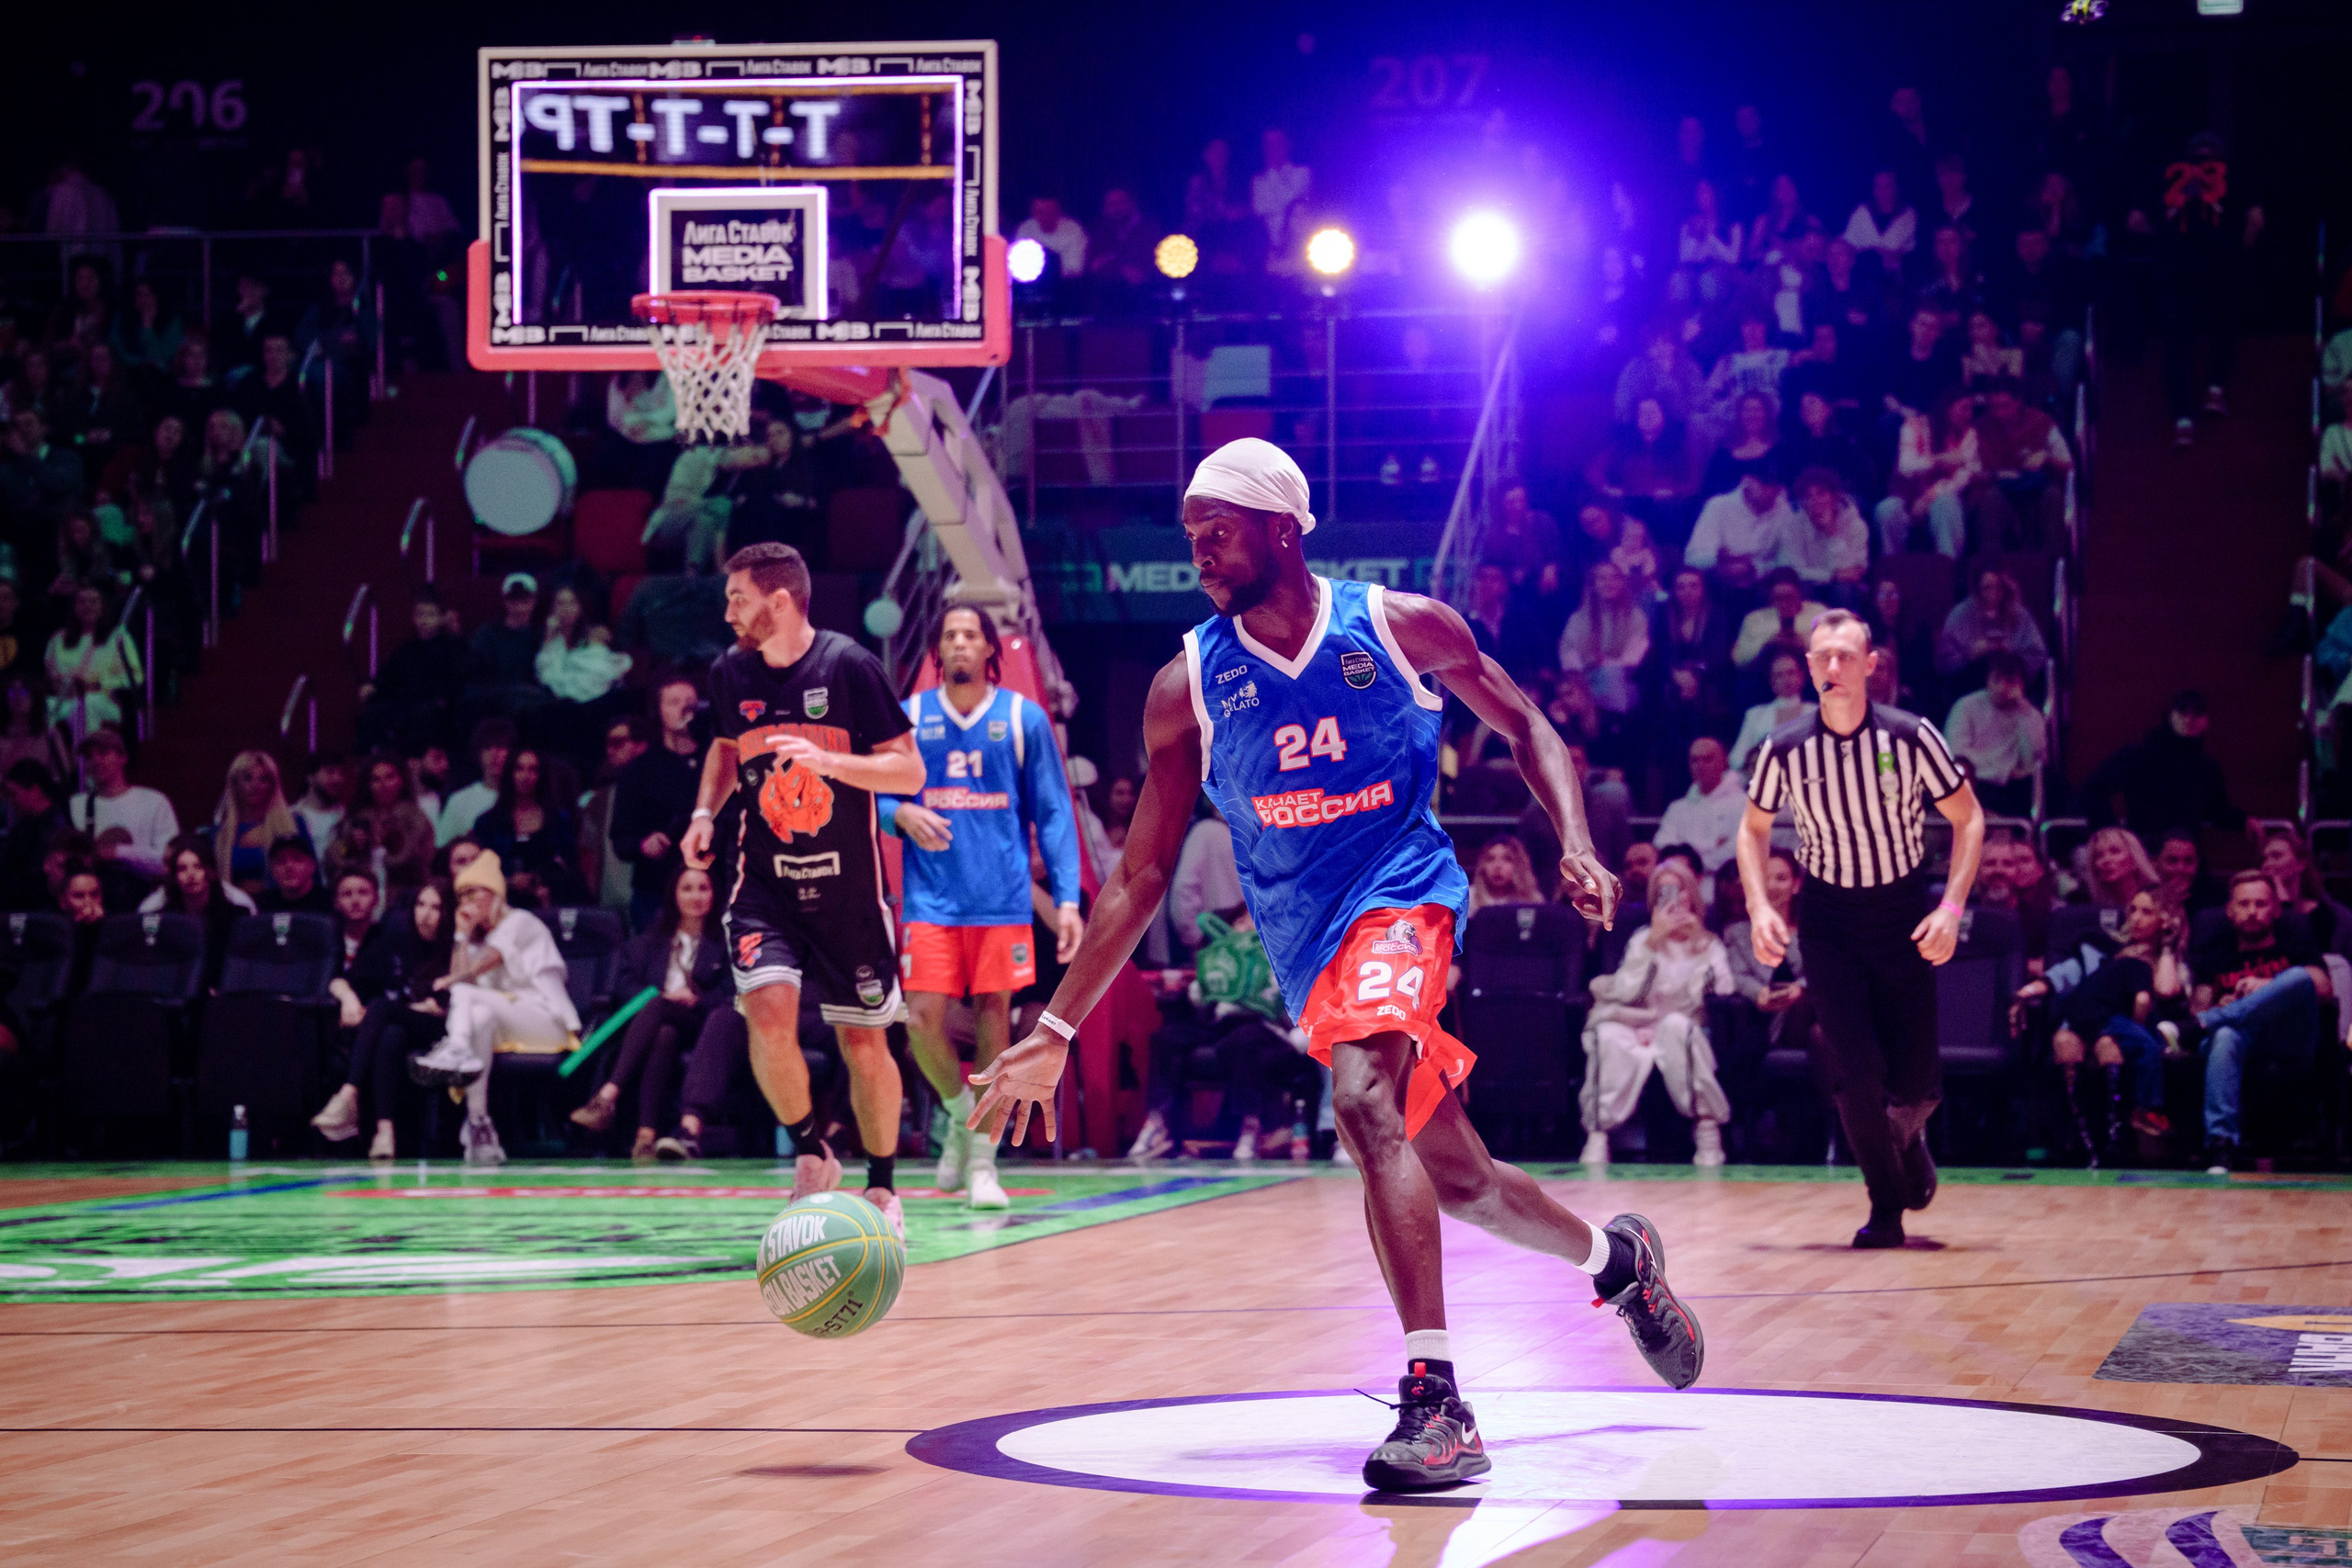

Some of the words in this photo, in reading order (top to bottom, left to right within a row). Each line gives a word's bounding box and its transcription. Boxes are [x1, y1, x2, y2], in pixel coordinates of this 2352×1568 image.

[1368, 56, 1489, 107] 207
[682, 244, 794, 266] MEDIA
[682, 265, 795, 283] BASKET
[1107, 561, 1199, 593] MED
[1215, 664, 1248, 685] ZEDO
[1342, 661, 1374, 671] MEDIA
[1343, 666, 1376, 677] BASKET
[1273, 716, 1348, 772] 24
[946, 749, 983, 779] 21
[1254, 791, 1322, 810] КАЧАЕТ
[1258, 782, 1392, 826] РОССИЯ
[1357, 961, 1424, 1010] 24
[1376, 1005, 1407, 1021] ZEDO
[767, 1214, 827, 1262] STAVOK
[778, 1255, 842, 1311] BASKET
